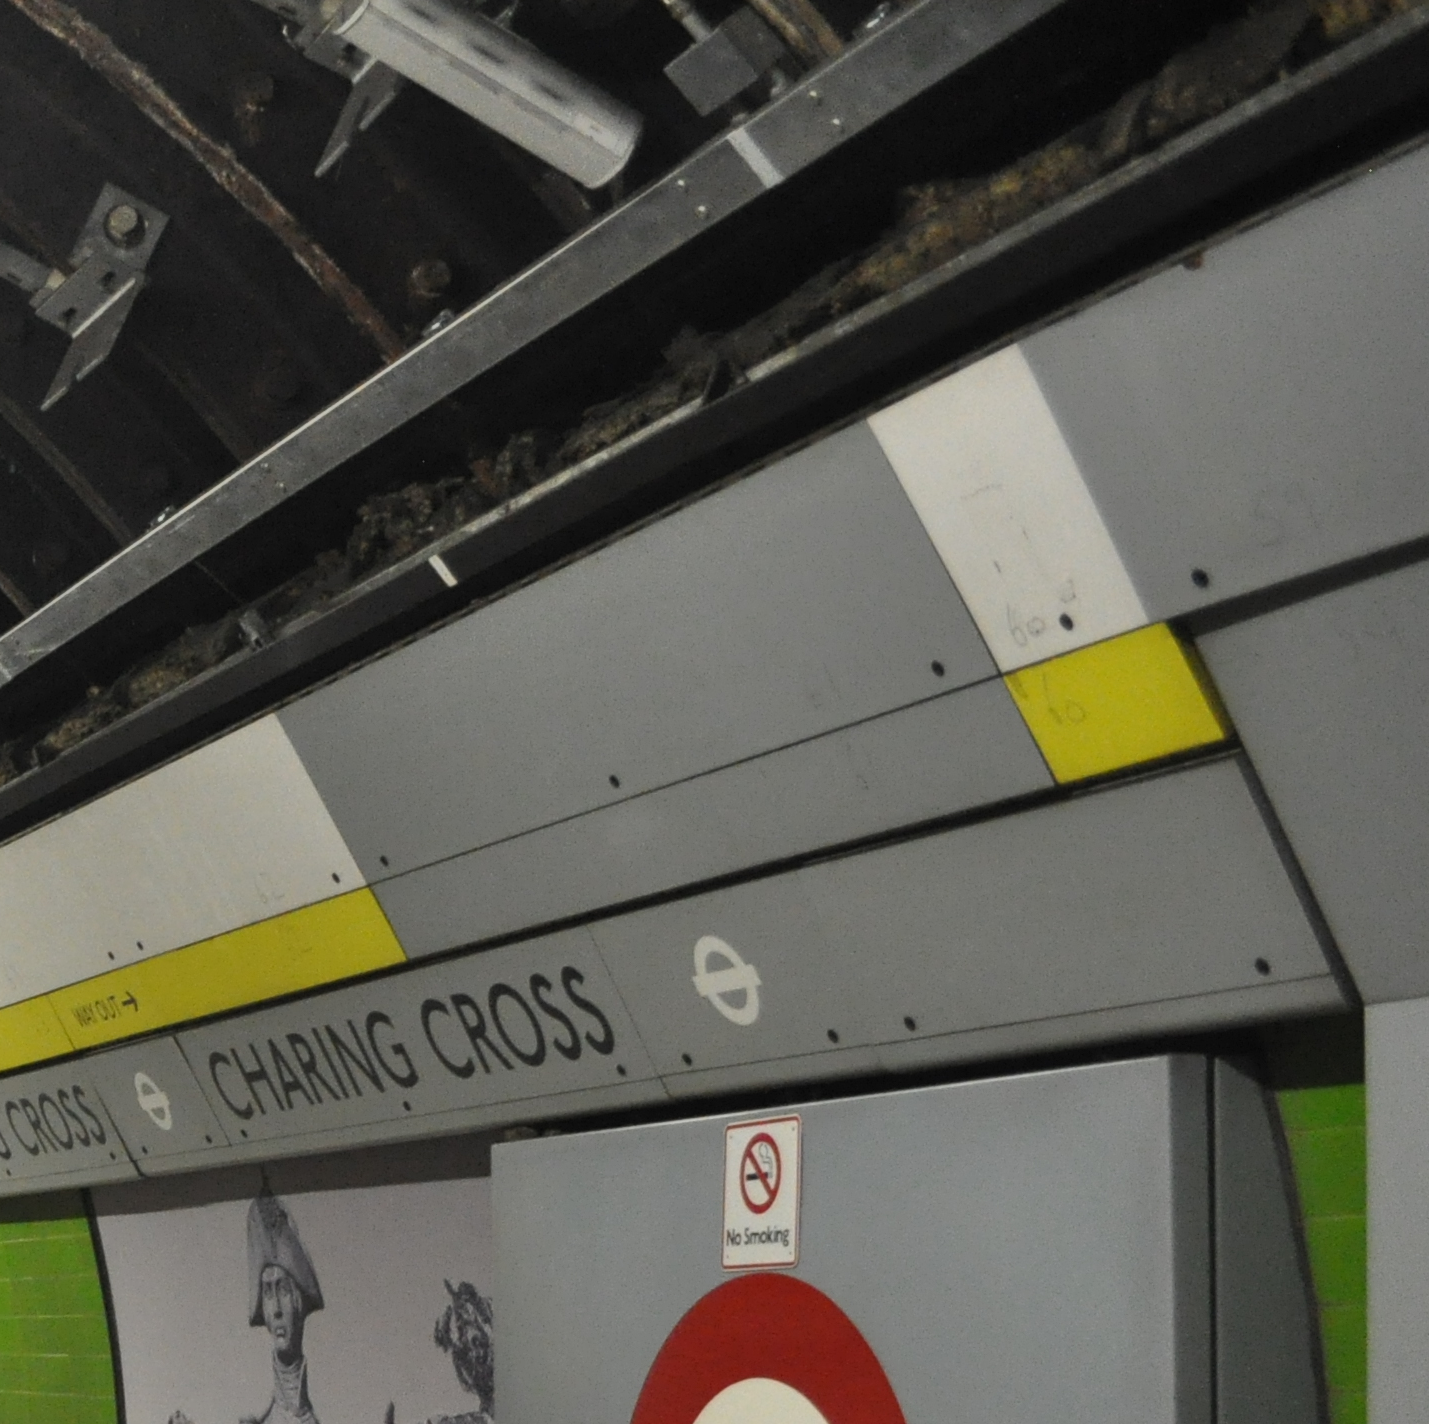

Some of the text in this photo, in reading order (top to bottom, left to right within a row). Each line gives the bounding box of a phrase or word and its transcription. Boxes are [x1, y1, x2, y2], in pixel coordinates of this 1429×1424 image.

[208, 966, 615, 1120] CHARING CROSS
[5, 1085, 107, 1156] CROSS
[726, 1226, 789, 1247] No Smoking
